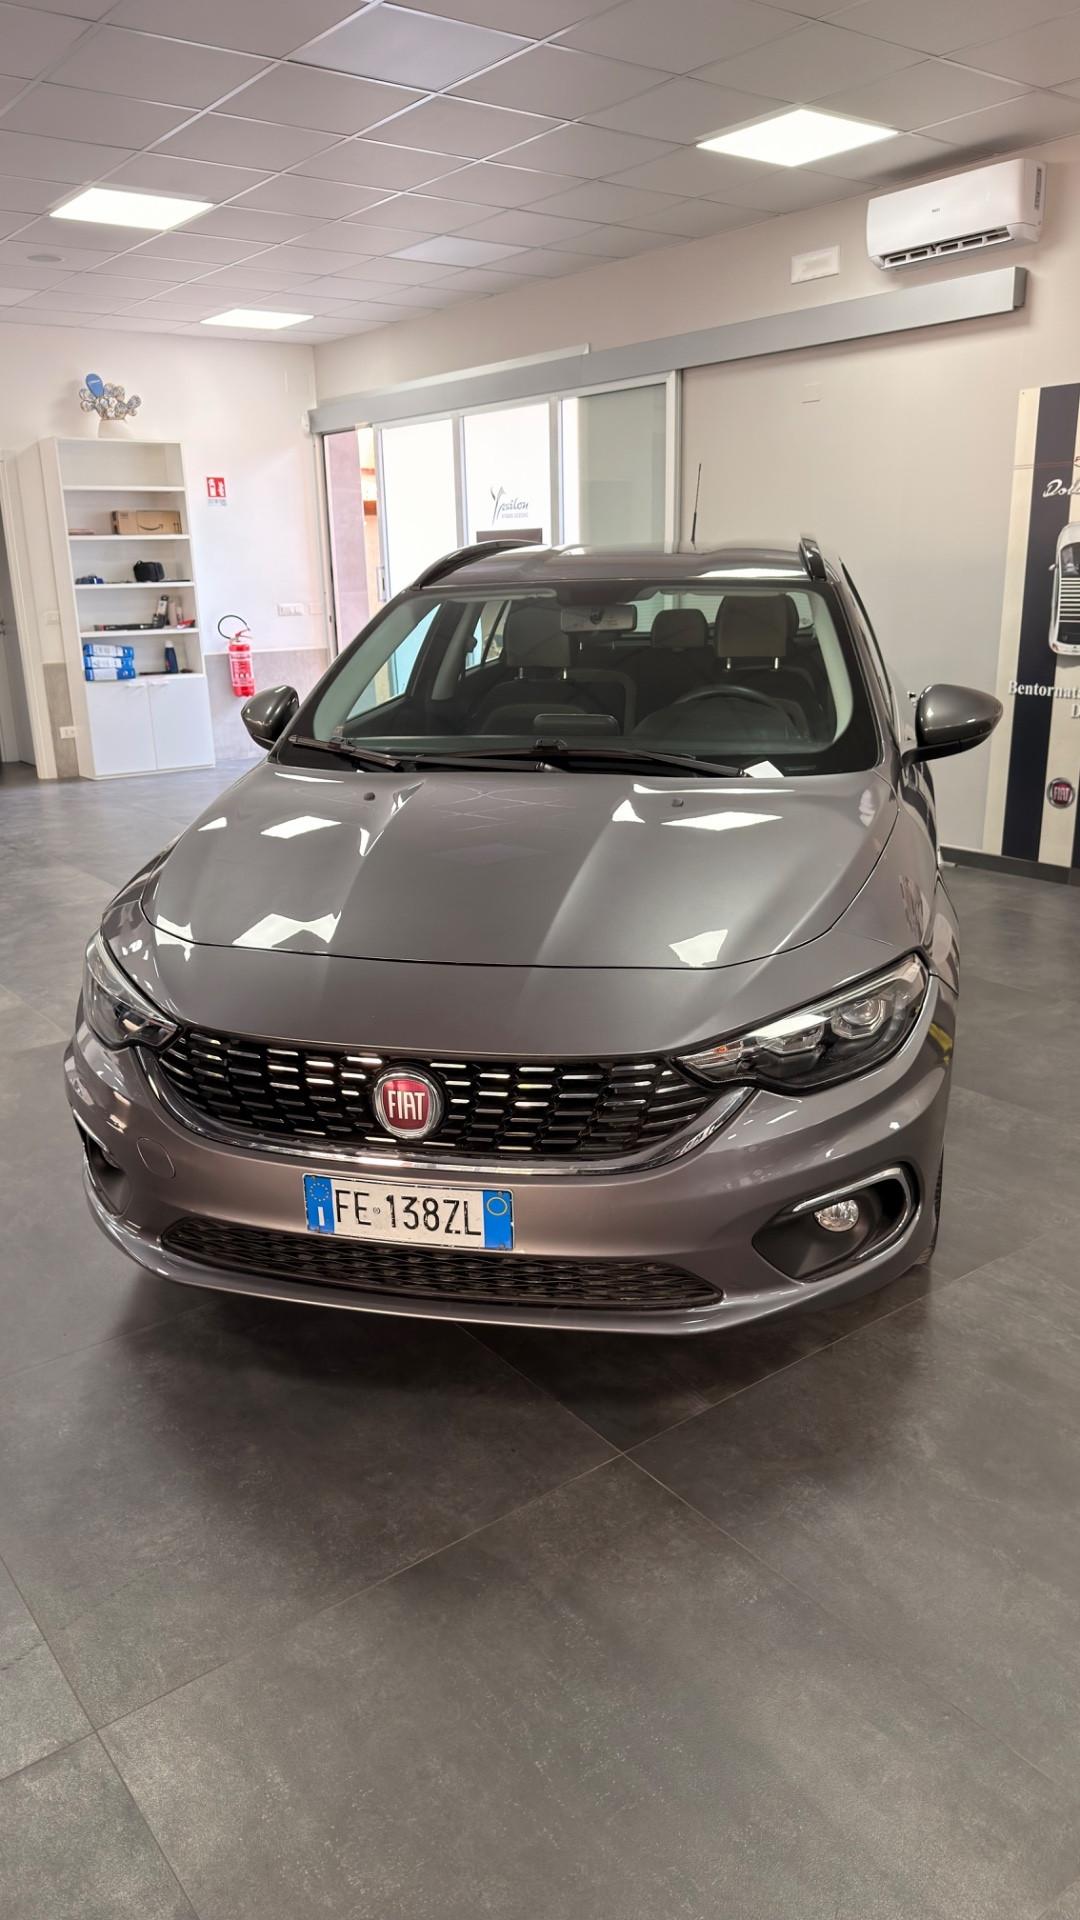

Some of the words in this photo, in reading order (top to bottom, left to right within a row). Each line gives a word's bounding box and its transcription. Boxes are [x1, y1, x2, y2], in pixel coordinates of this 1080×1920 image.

[1008, 680, 1080, 700] Bentornat
[1053, 786, 1070, 801] FIAT
[387, 1090, 426, 1121] FIAT
[334, 1189, 371, 1226] FE
[386, 1194, 482, 1236] 138ZL
